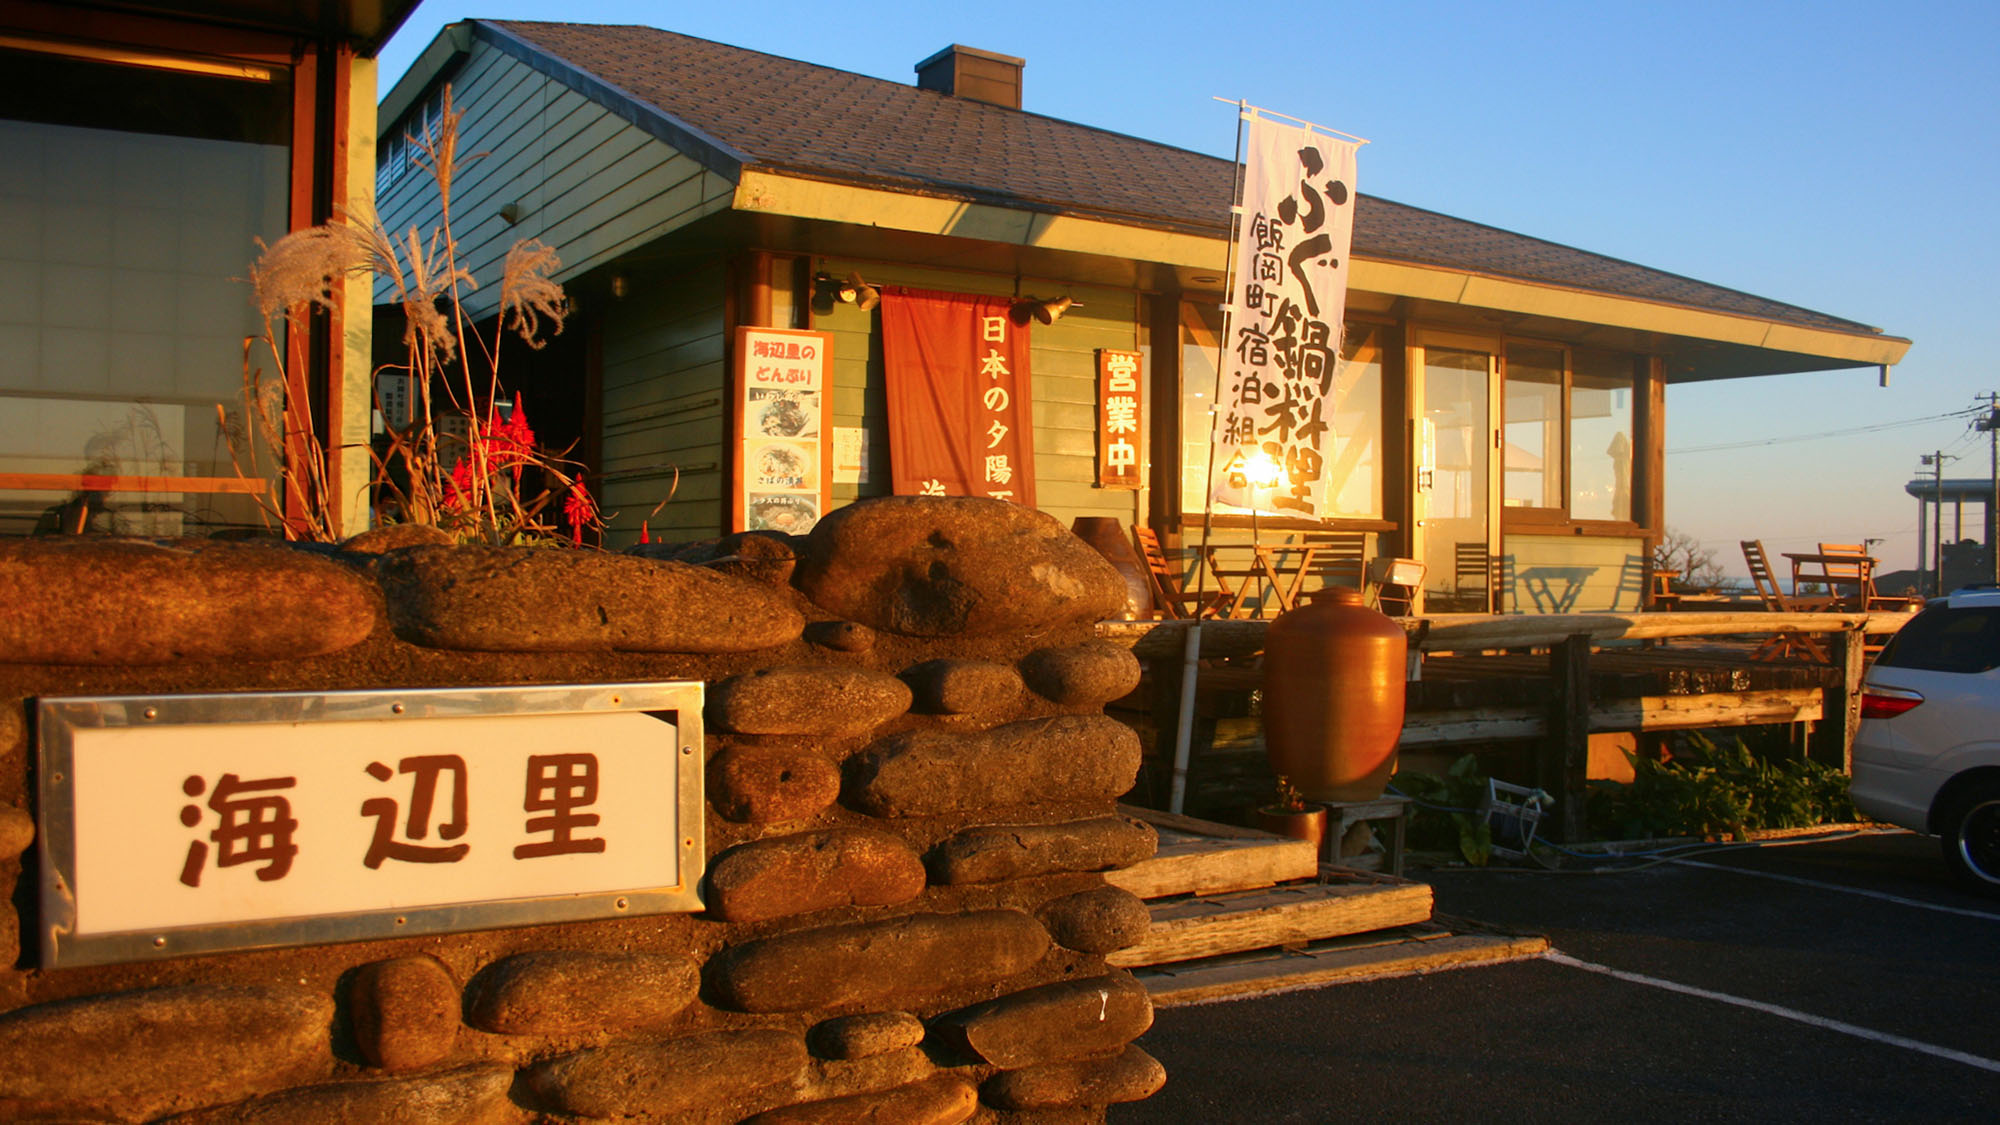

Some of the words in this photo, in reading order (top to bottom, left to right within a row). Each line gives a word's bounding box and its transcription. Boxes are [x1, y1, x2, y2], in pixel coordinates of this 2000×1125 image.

[753, 340, 816, 361] 海辺里の
[755, 366, 812, 385] どんぶり
[1258, 146, 1349, 516] ふぐ鍋料理
[1106, 354, 1137, 476] 営業中
[179, 753, 606, 888] 海辺里
